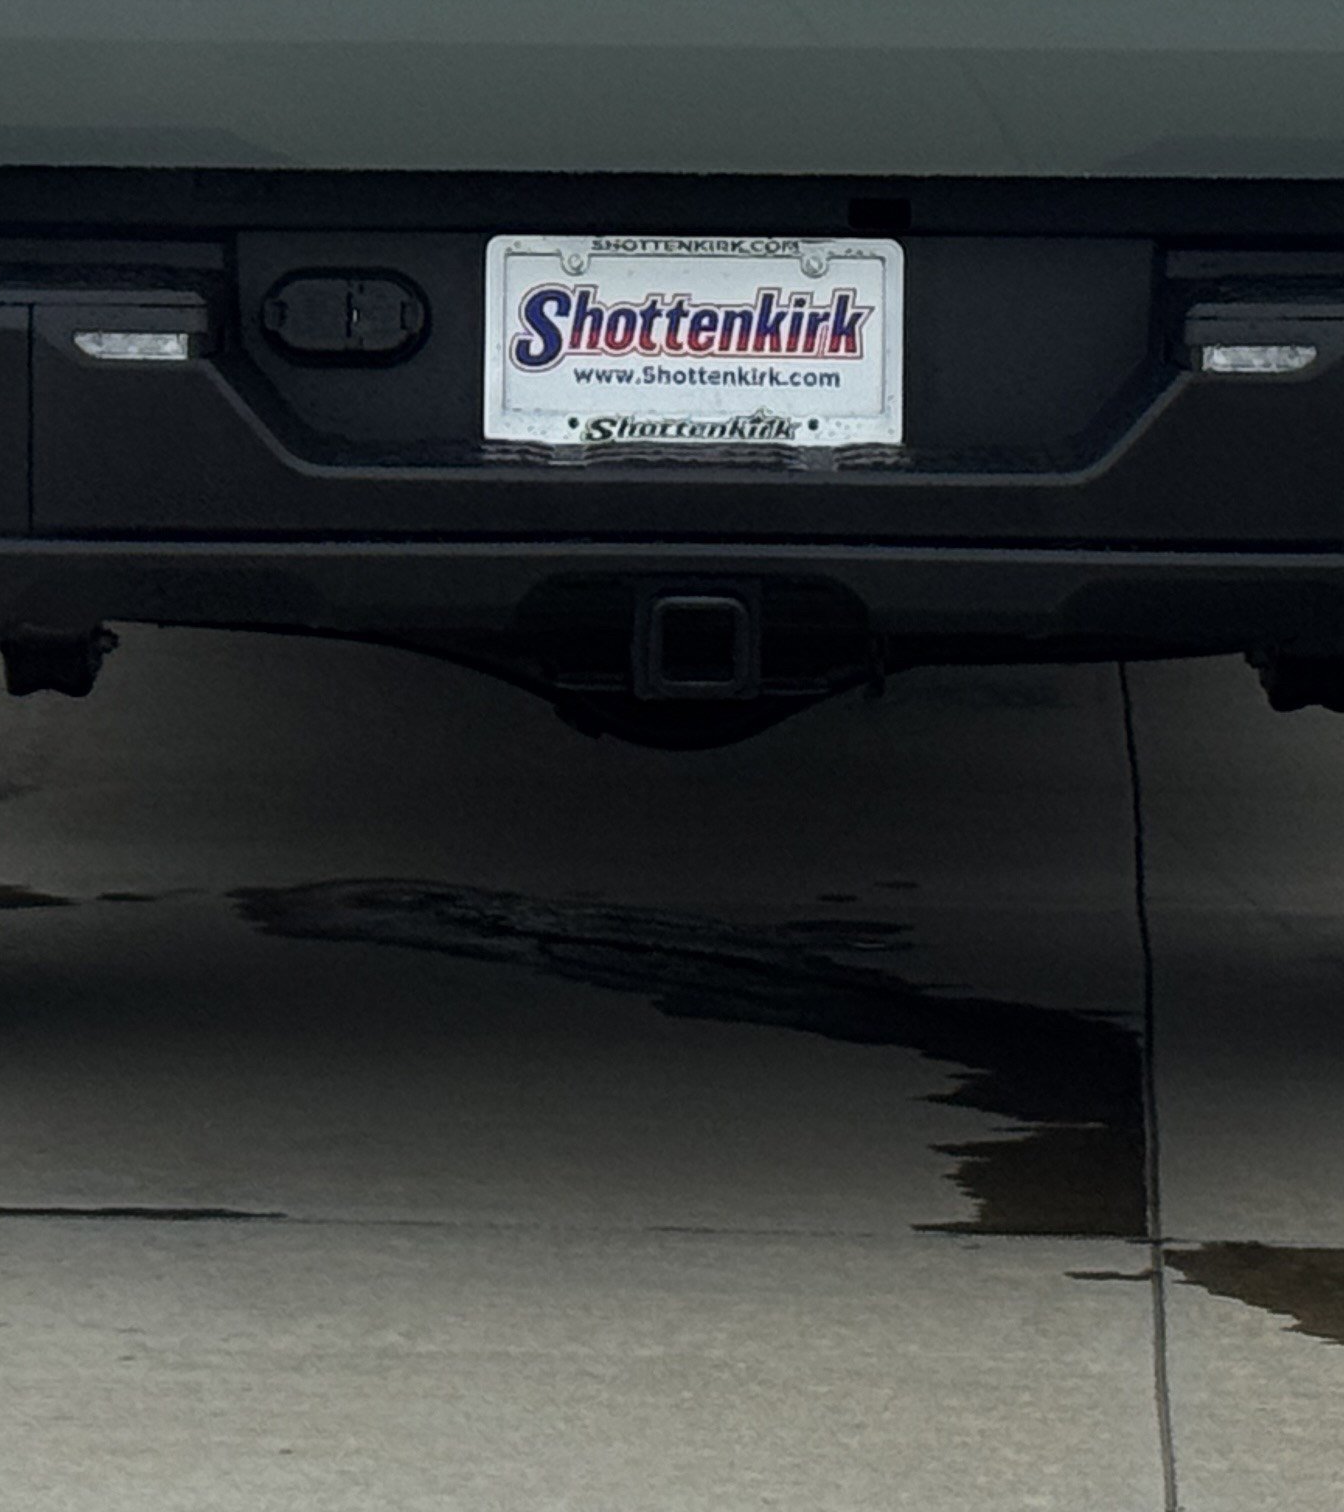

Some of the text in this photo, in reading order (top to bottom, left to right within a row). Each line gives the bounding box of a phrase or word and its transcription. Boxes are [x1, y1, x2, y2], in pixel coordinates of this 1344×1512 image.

[590, 238, 801, 254] SHOTTENKIRK.COM
[510, 284, 873, 371] Shottenkirk
[573, 365, 841, 388] www.Shottenkirk.com
[582, 412, 802, 441] Shottenkirk
